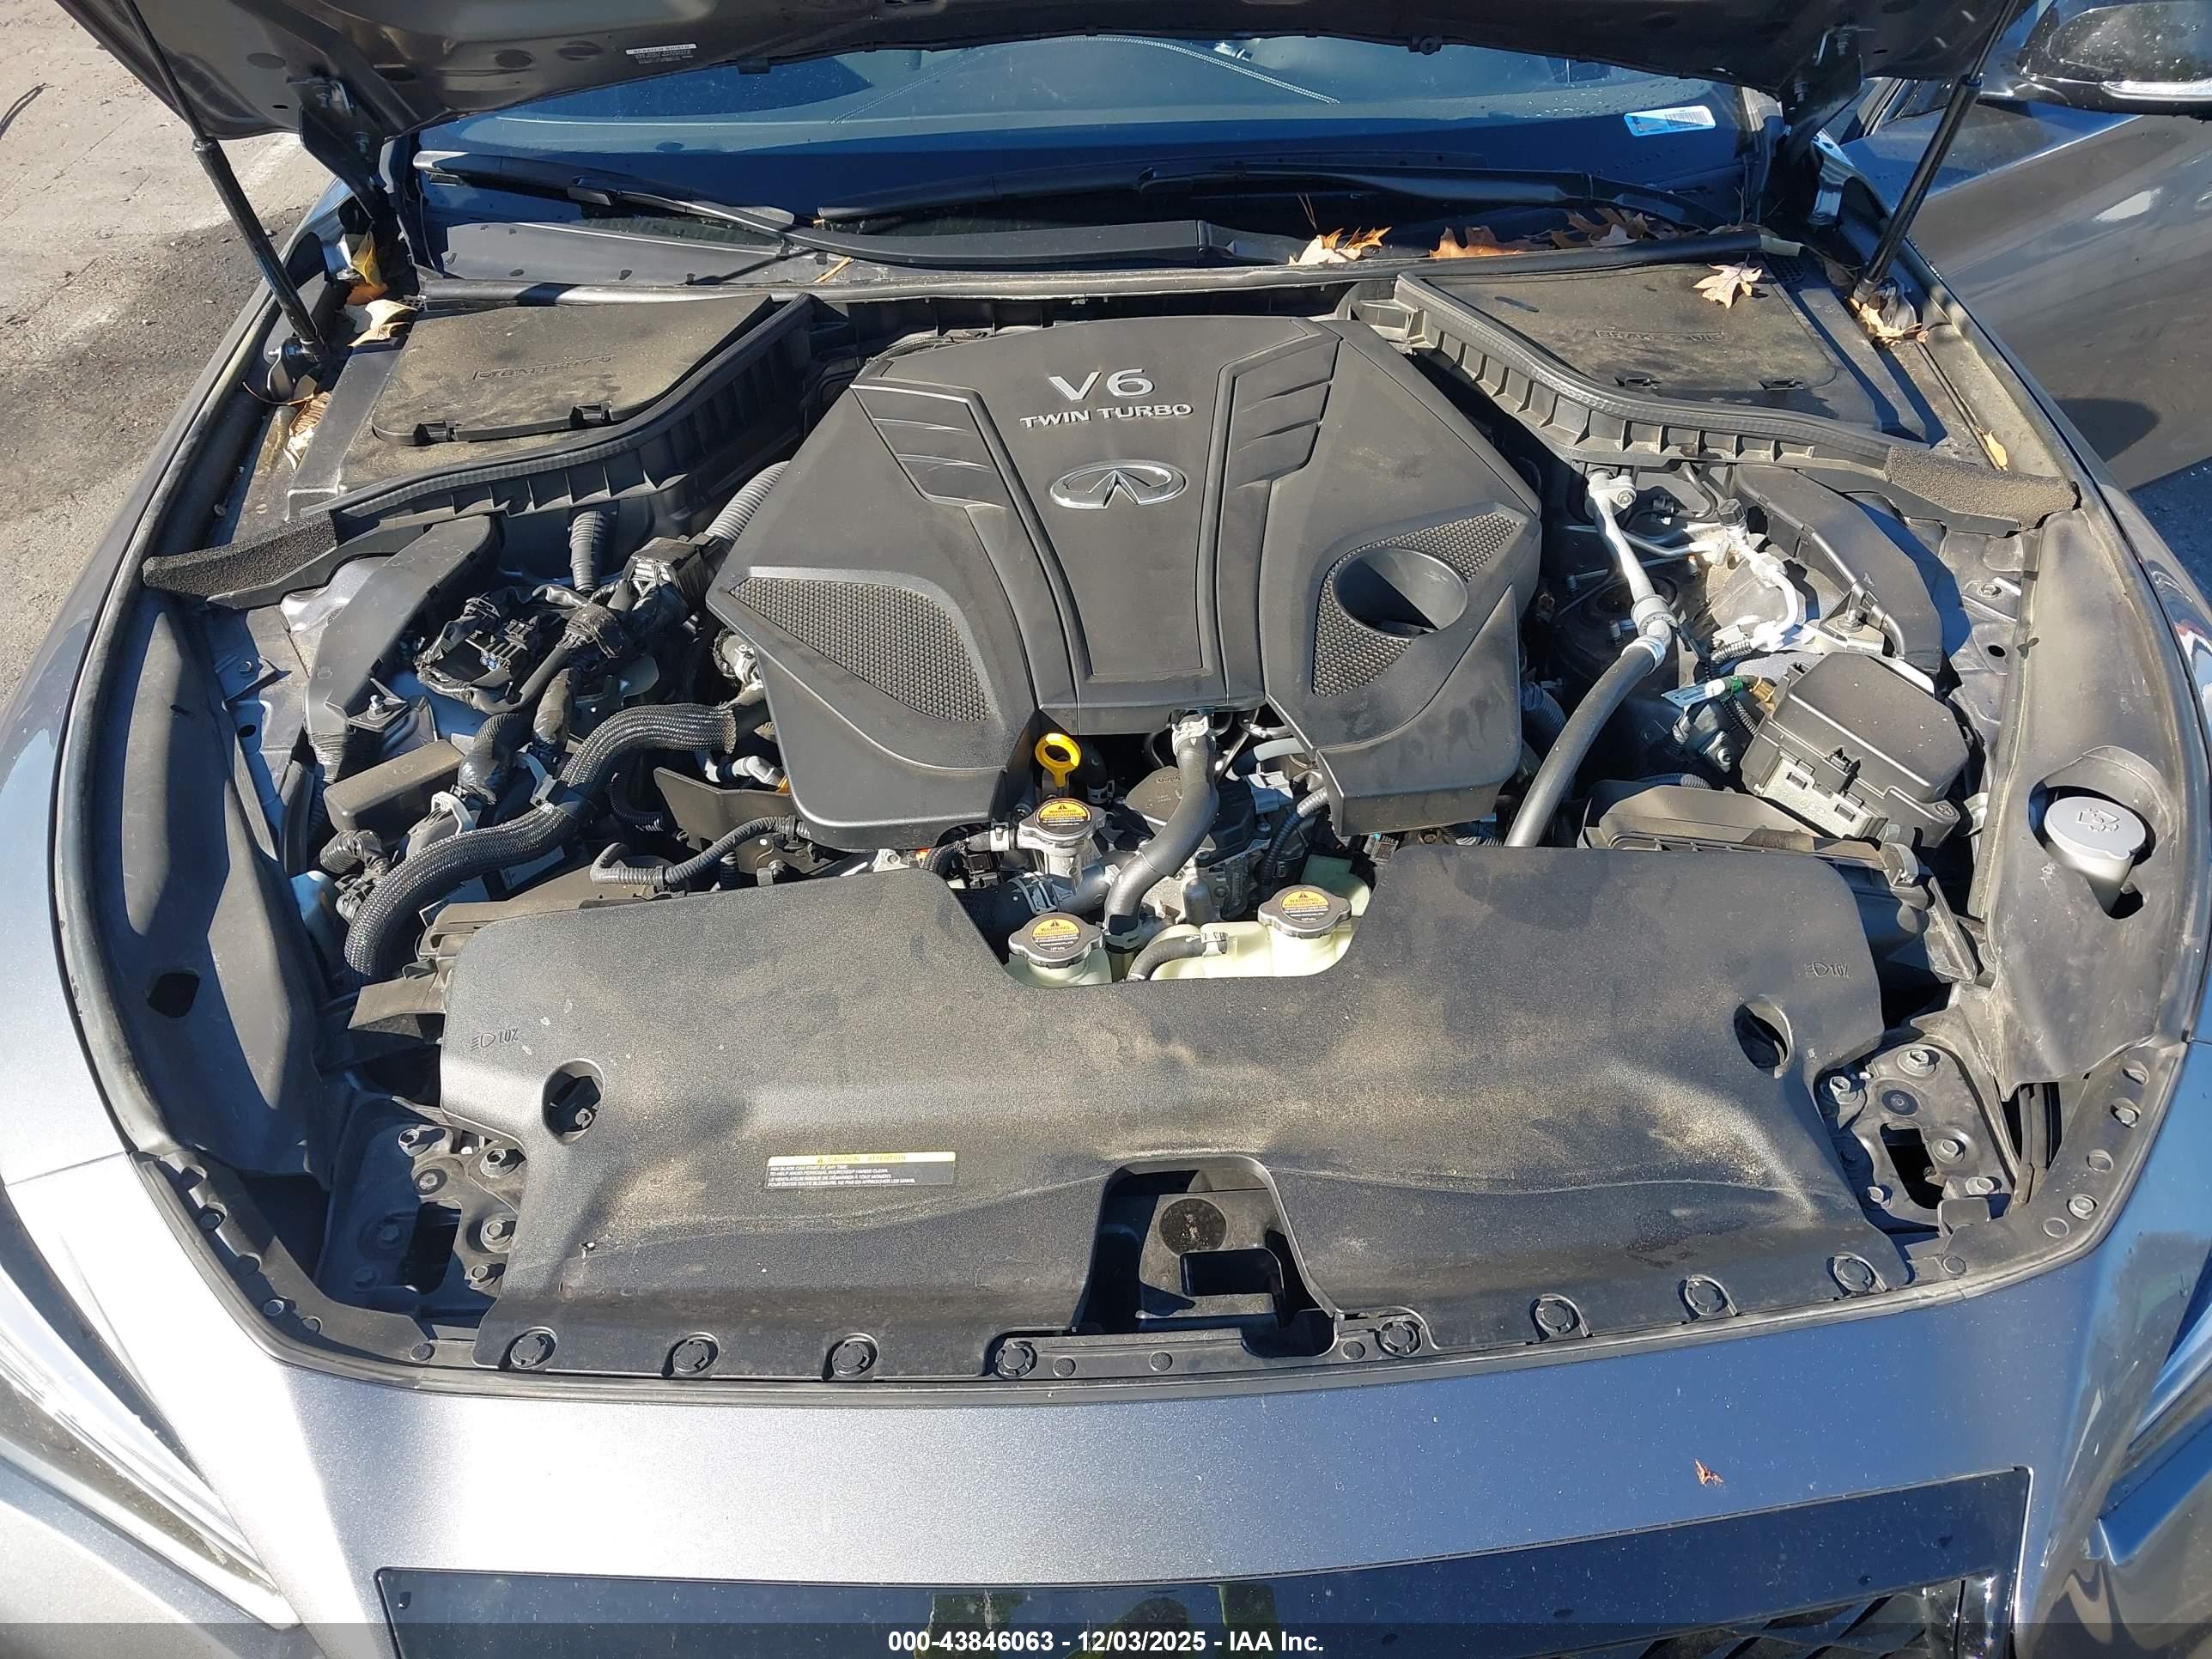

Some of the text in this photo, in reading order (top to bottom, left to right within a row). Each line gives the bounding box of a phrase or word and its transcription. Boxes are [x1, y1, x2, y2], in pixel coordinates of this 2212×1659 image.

[1048, 368, 1155, 402] V6
[1020, 404, 1195, 430] TWIN TURBO
